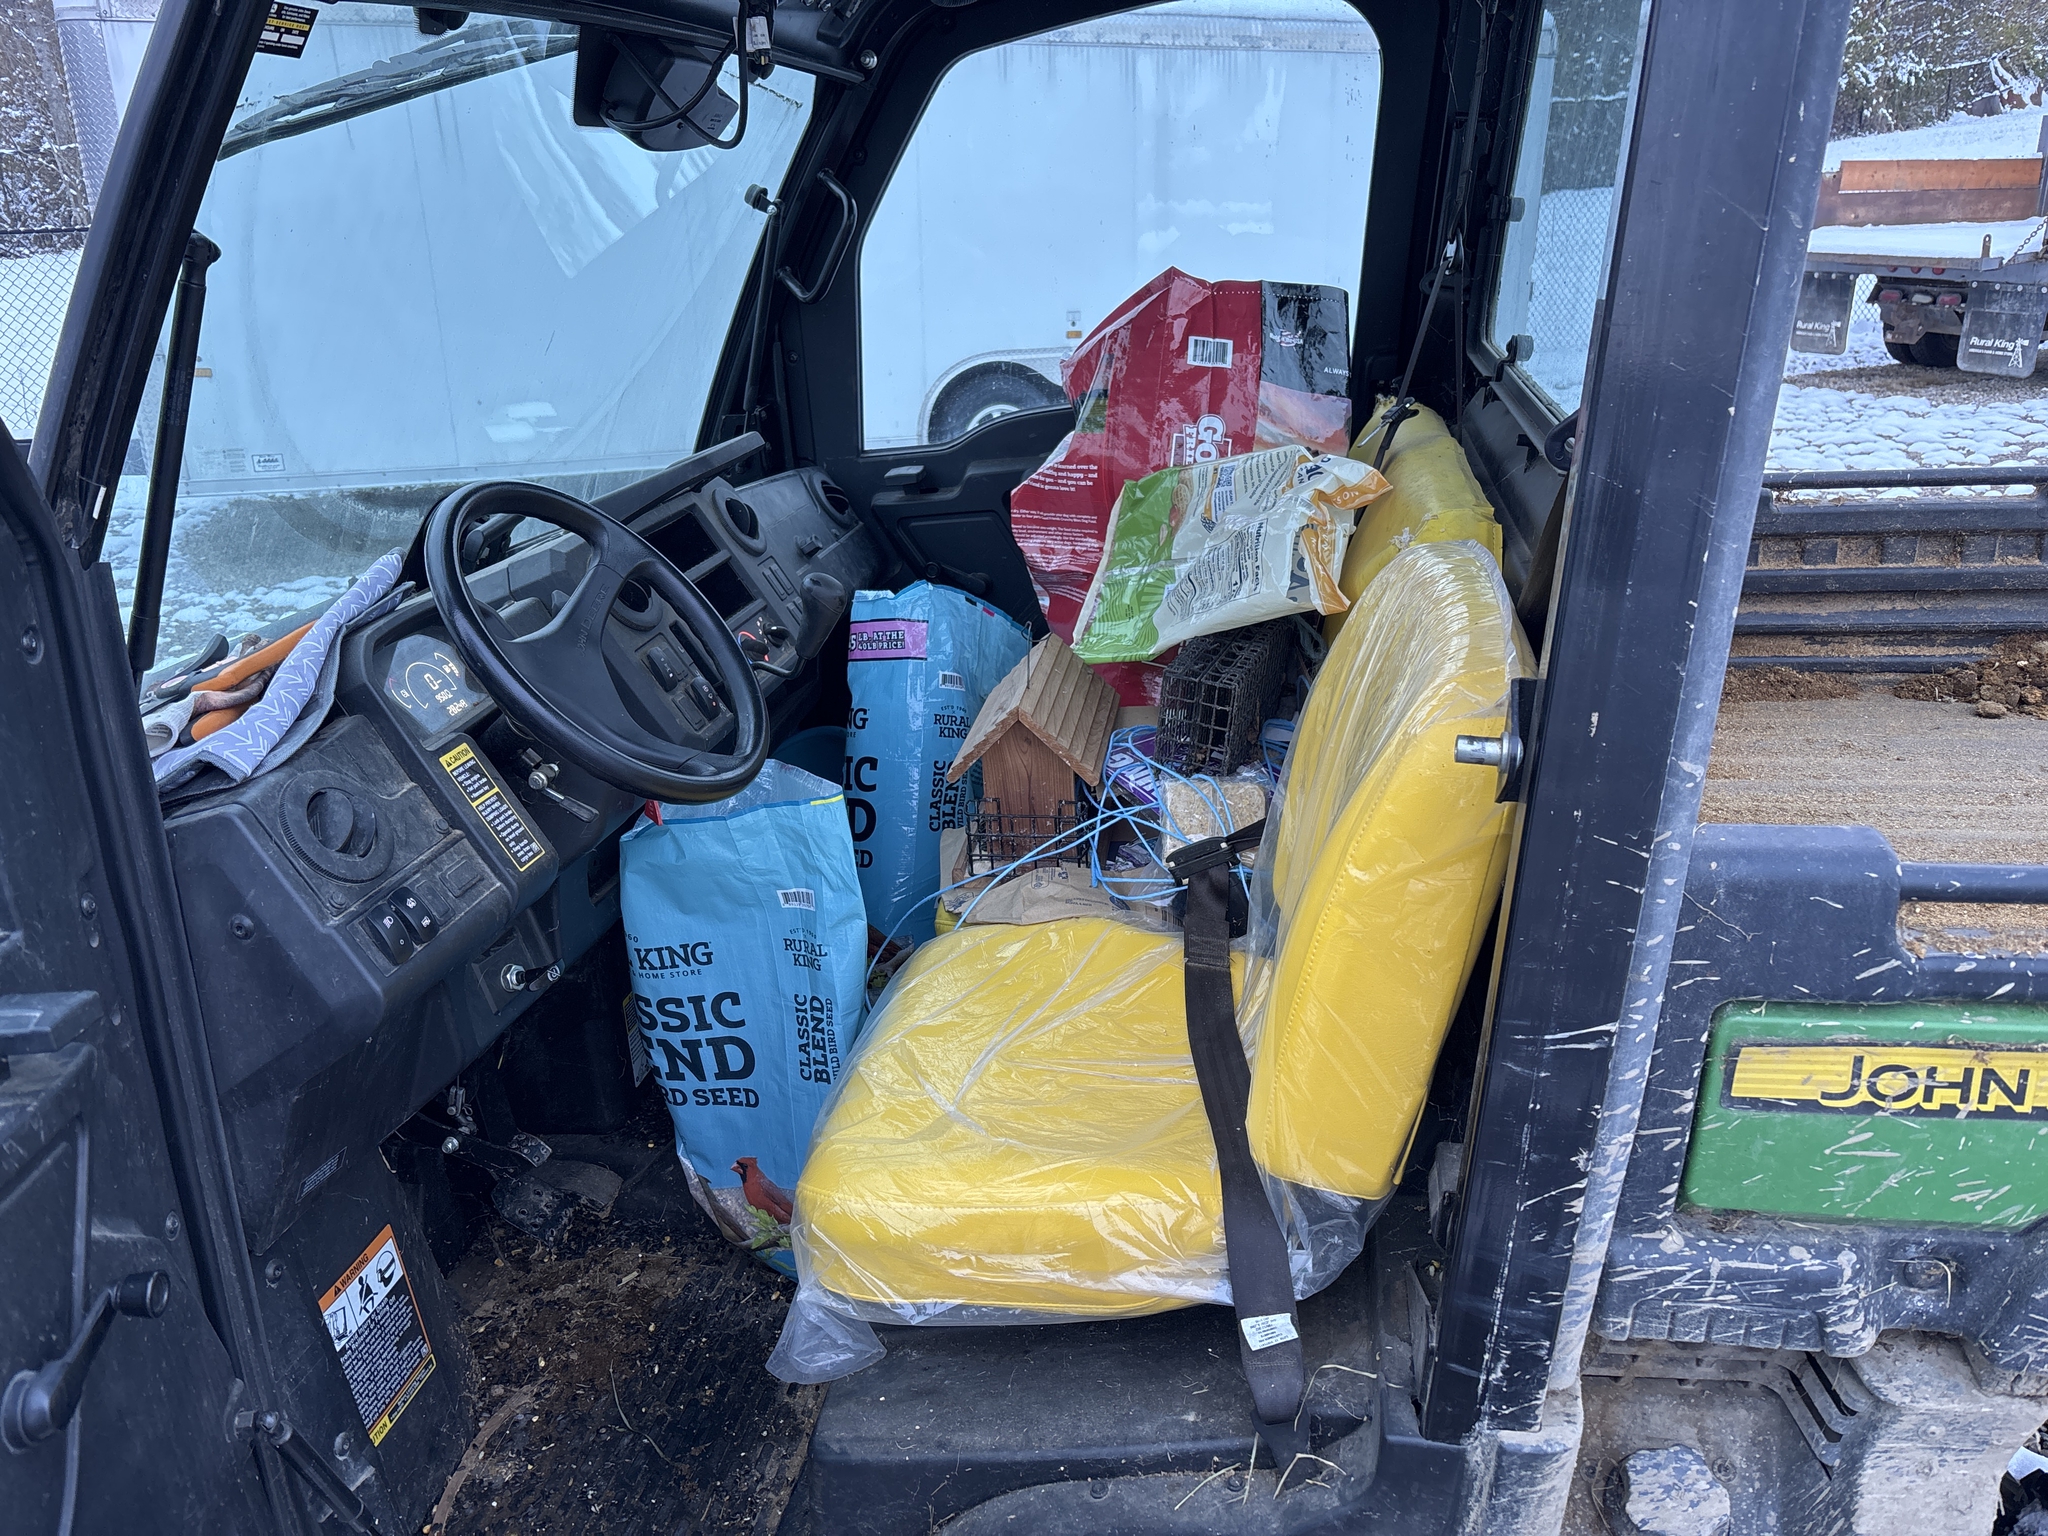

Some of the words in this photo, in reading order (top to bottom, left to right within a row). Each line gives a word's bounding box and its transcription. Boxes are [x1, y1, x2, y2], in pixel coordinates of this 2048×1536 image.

[1796, 320, 1814, 330] Rural
[1814, 321, 1830, 332] King
[1970, 337, 1993, 347] Rural
[1994, 339, 2015, 351] King
[1324, 367, 1349, 376] ALWAYS
[1255, 522, 1264, 563] Nutrition
[873, 632, 884, 641] AT
[885, 631, 904, 640] THE
[934, 714, 970, 728] RURAL
[939, 727, 967, 739] KING
[448, 746, 470, 764] CAUTION
[929, 760, 946, 832] CLASSIC
[942, 761, 959, 831] BLEN
[849, 798, 877, 842] D
[634, 941, 713, 971] KING
[783, 938, 828, 957] RURAL
[638, 971, 665, 980] HOME
[669, 968, 702, 978] STORE
[792, 953, 822, 971] KING
[825, 998, 834, 1028] SEED
[794, 994, 812, 1081] CLASSIC
[810, 995, 831, 1085] BLEND
[827, 1029, 838, 1055] BIRD
[1820, 1055, 2031, 1106] JOHN
[694, 1086, 760, 1109] SEED
[339, 1252, 368, 1289] WARNING
[339, 1346, 352, 1365] from
[351, 1325, 370, 1352] Rollover
[374, 1302, 389, 1325] Falling
[388, 1293, 396, 1307] Off
[344, 1331, 358, 1351] Avoid
[357, 1316, 371, 1336] Injury
[375, 1295, 388, 1314] Death
